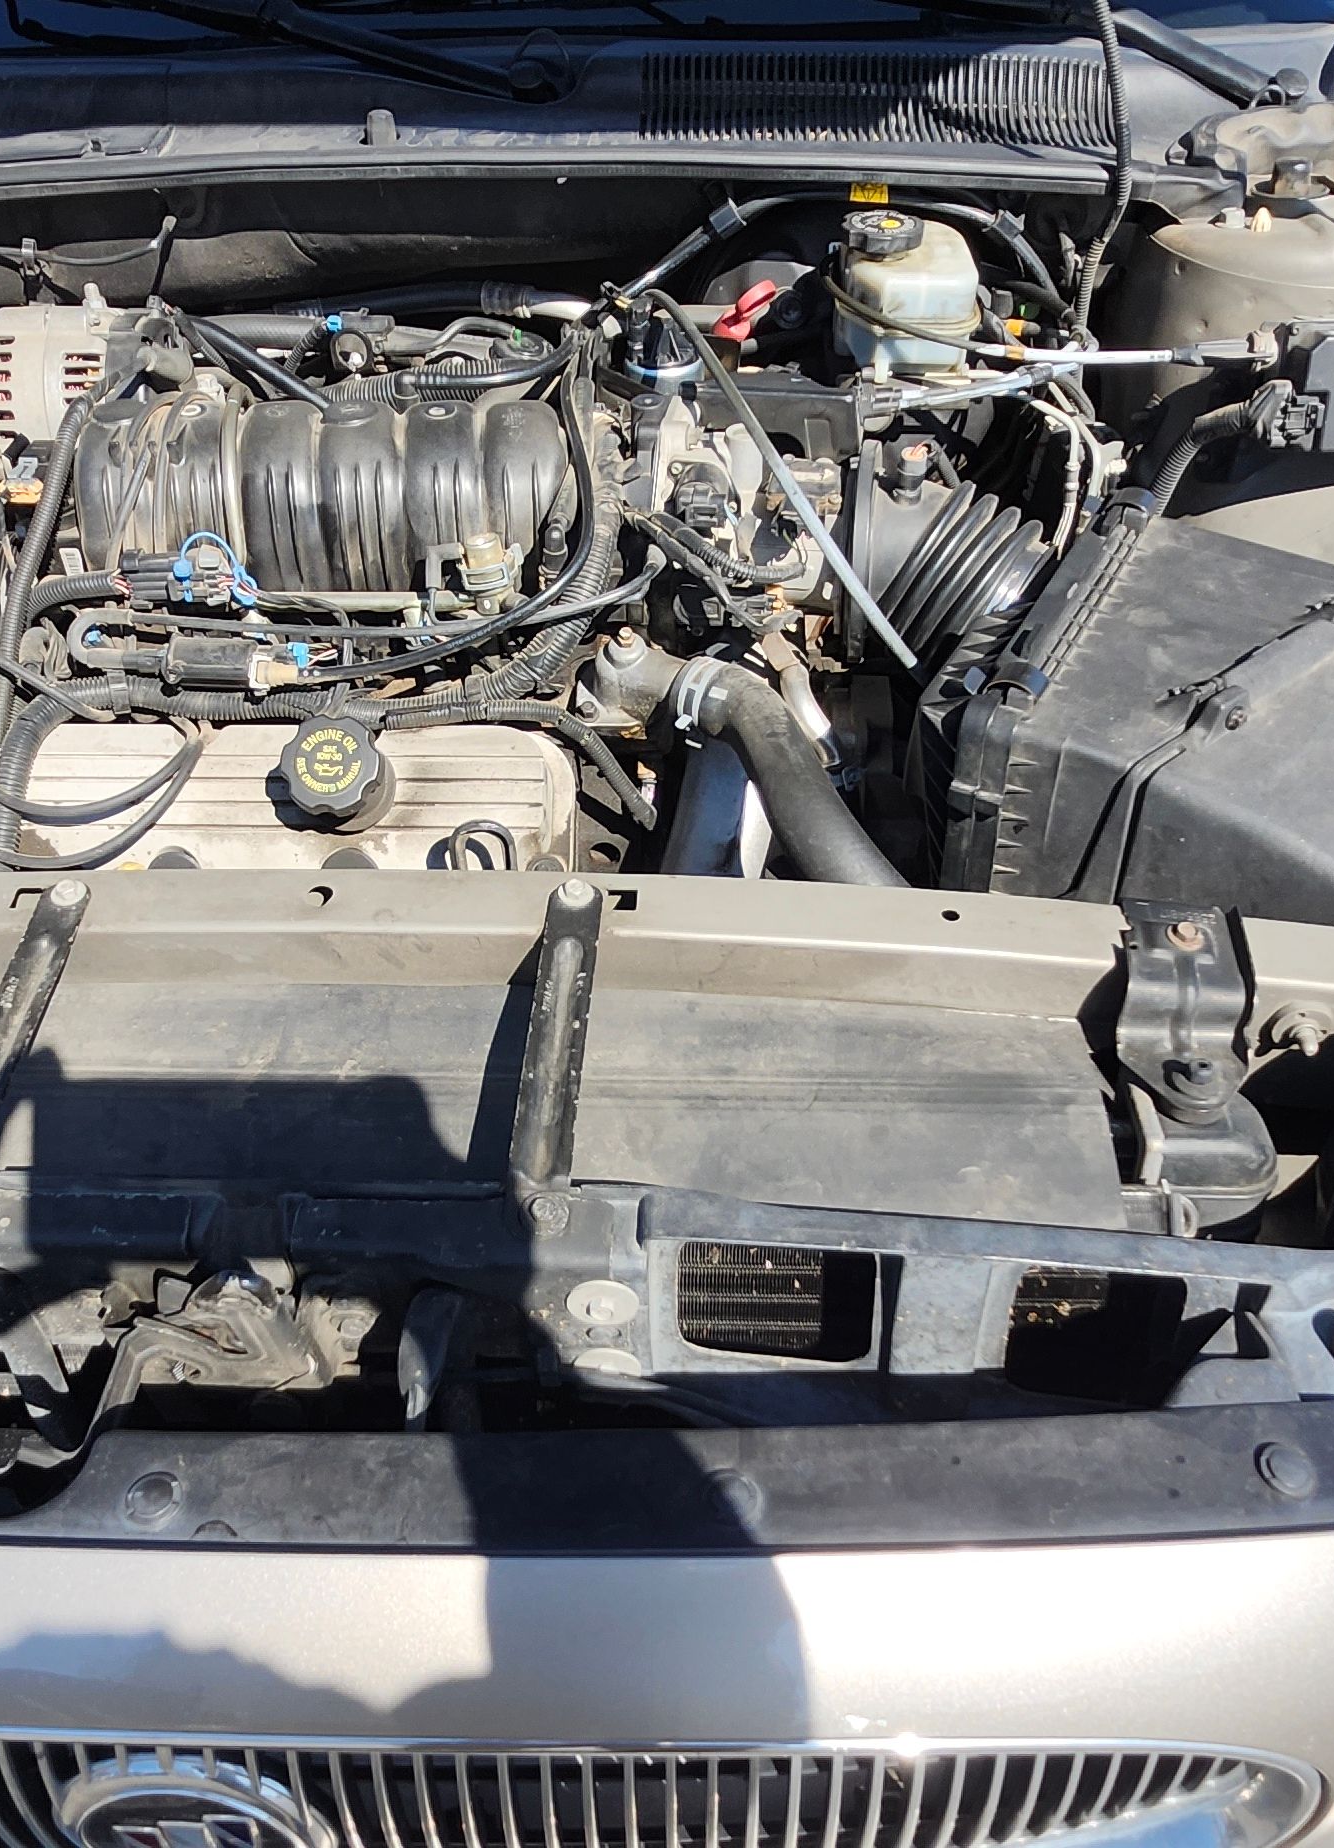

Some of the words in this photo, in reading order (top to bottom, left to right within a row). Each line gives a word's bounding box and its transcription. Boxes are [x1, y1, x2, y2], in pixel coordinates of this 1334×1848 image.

[301, 729, 344, 751] ENGINE
[343, 736, 357, 754] OIL
[297, 757, 307, 774] SEE
[336, 760, 361, 790] MANUAL
